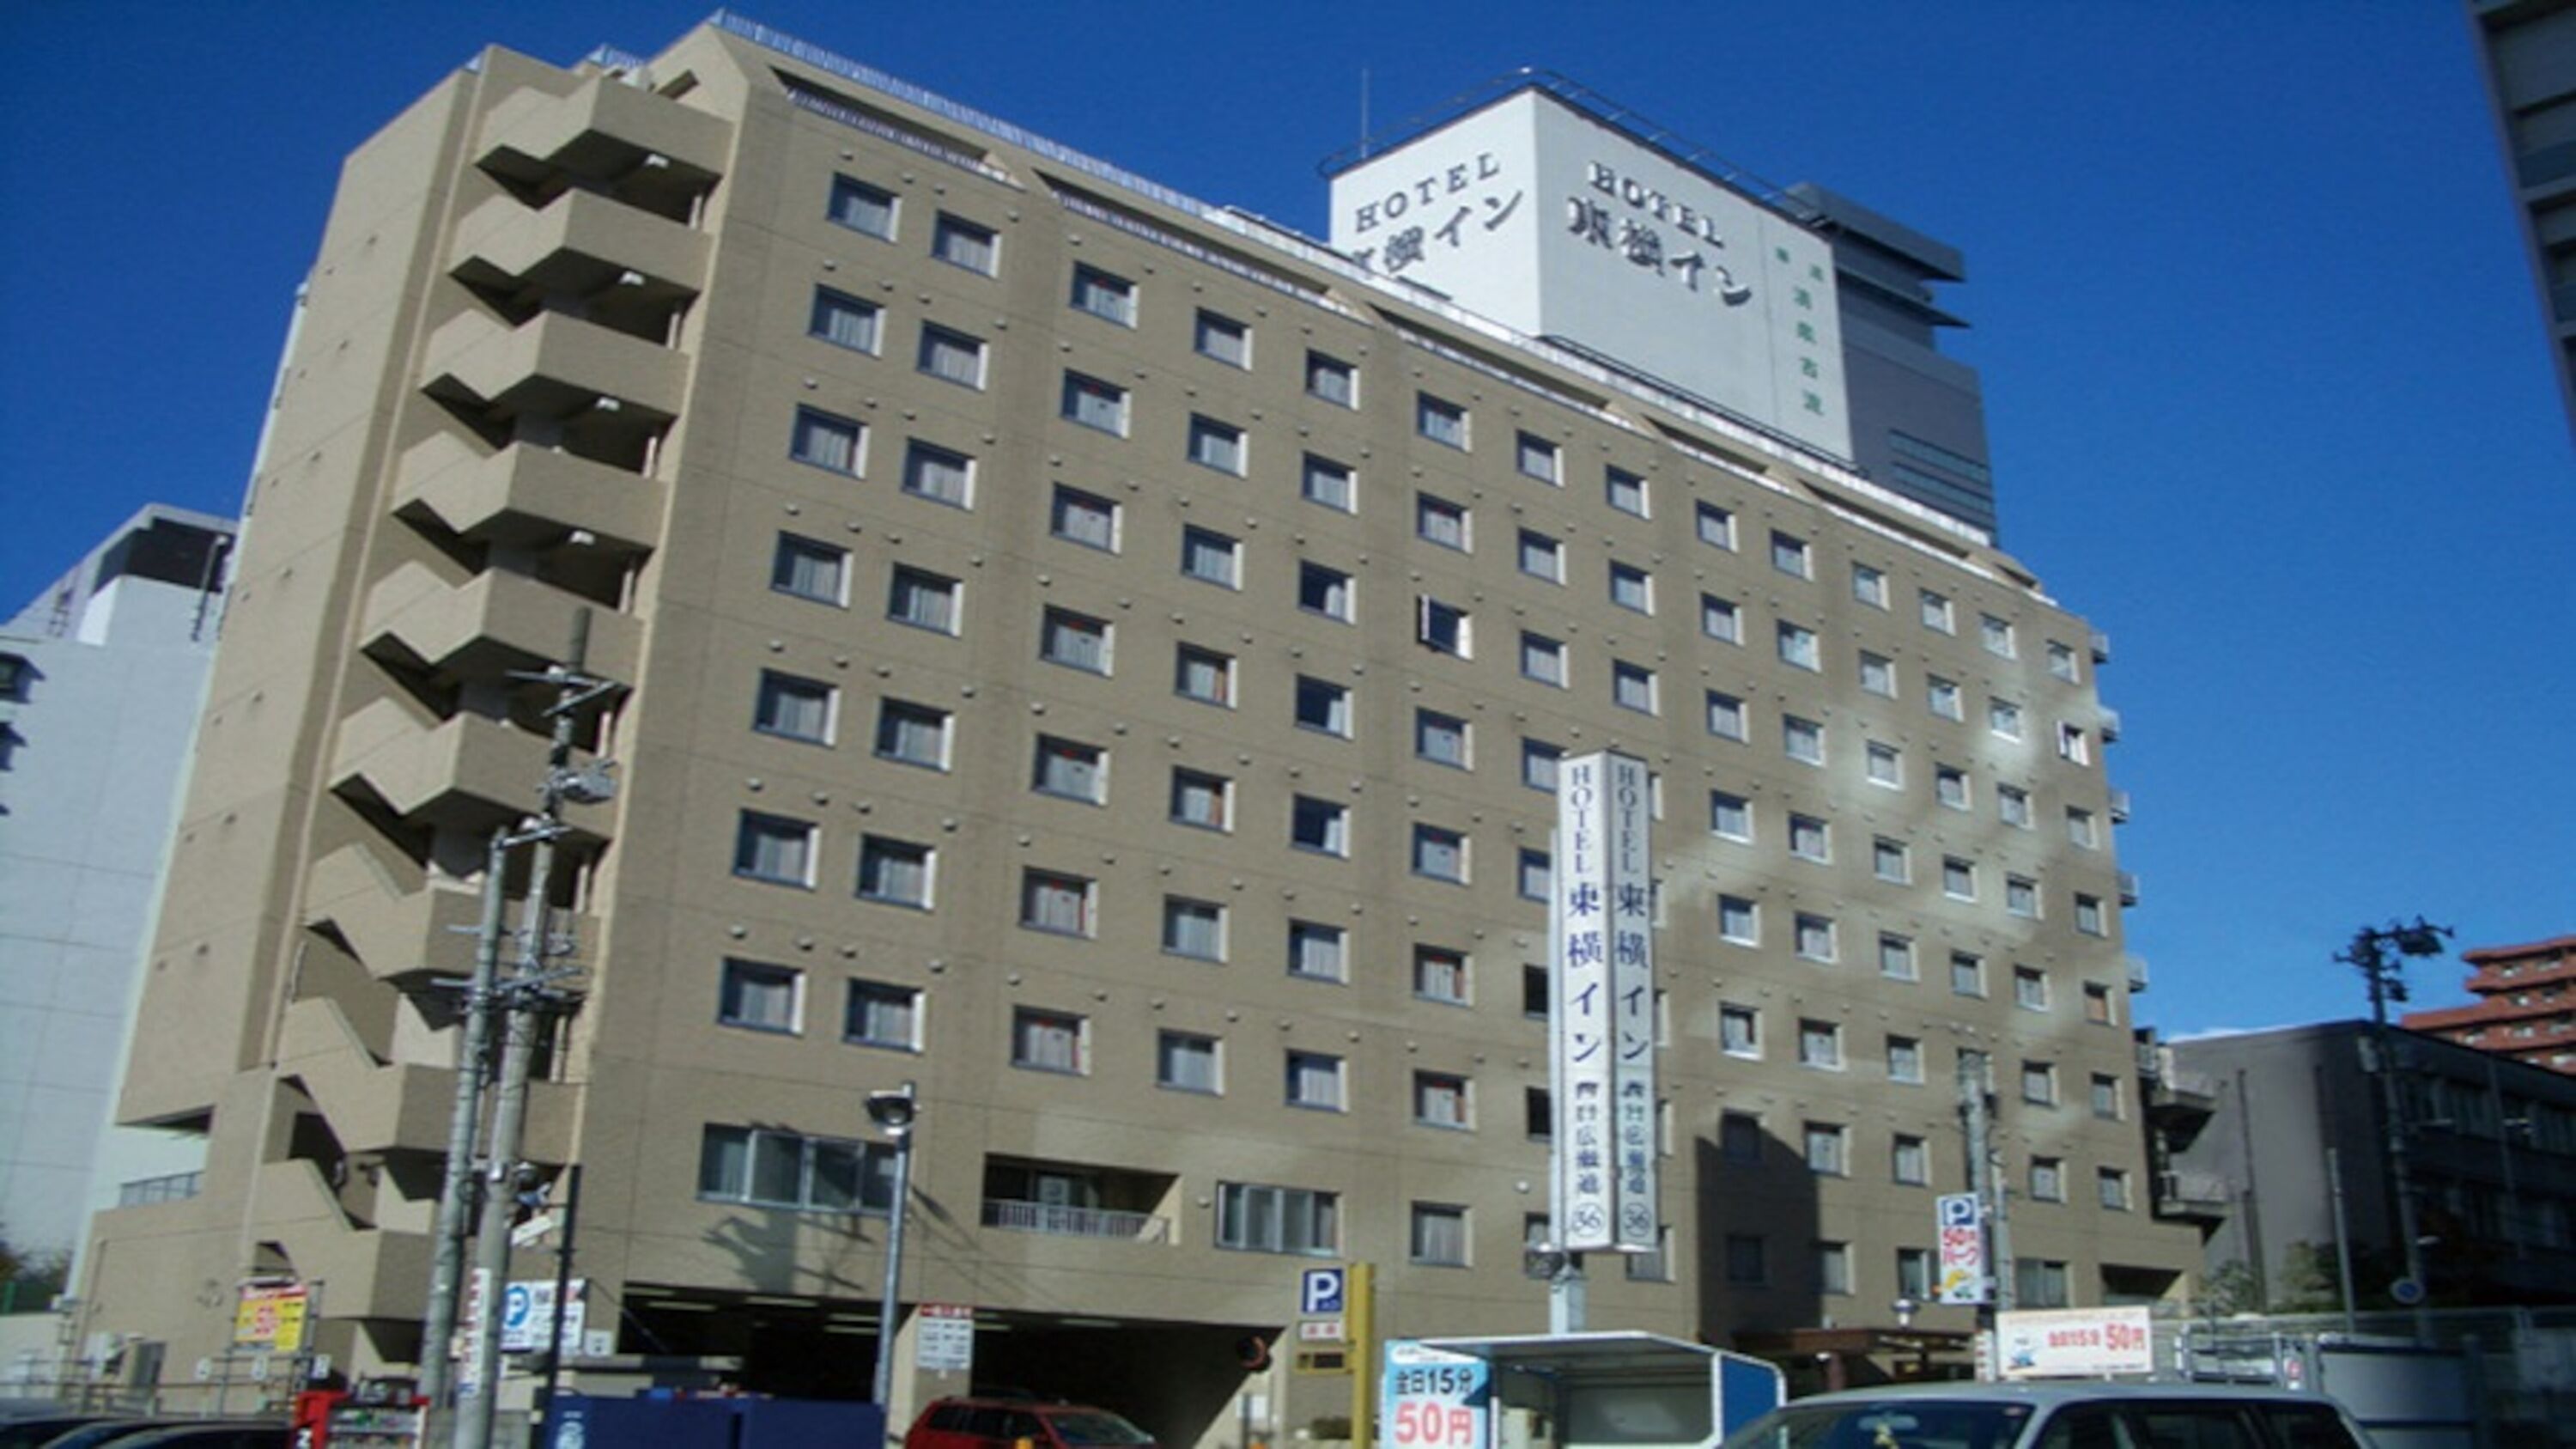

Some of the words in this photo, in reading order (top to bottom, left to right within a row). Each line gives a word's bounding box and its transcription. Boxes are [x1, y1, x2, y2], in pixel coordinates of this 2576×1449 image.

[1356, 152, 1500, 233] HOTEL
[1588, 161, 1724, 248] HOTEL
[1567, 196, 1753, 307] 東横イン
[1571, 764, 1592, 874] HOTEL
[1618, 764, 1637, 874] HOTEL
[1567, 882, 1602, 1062] 東横イン
[1616, 882, 1649, 1059] 東横イン
[1944, 1199, 1971, 1225] P
[1307, 1271, 1339, 1313] P
[1395, 1402, 1473, 1446] 50円
[1396, 1368, 1473, 1395] 全日15分
